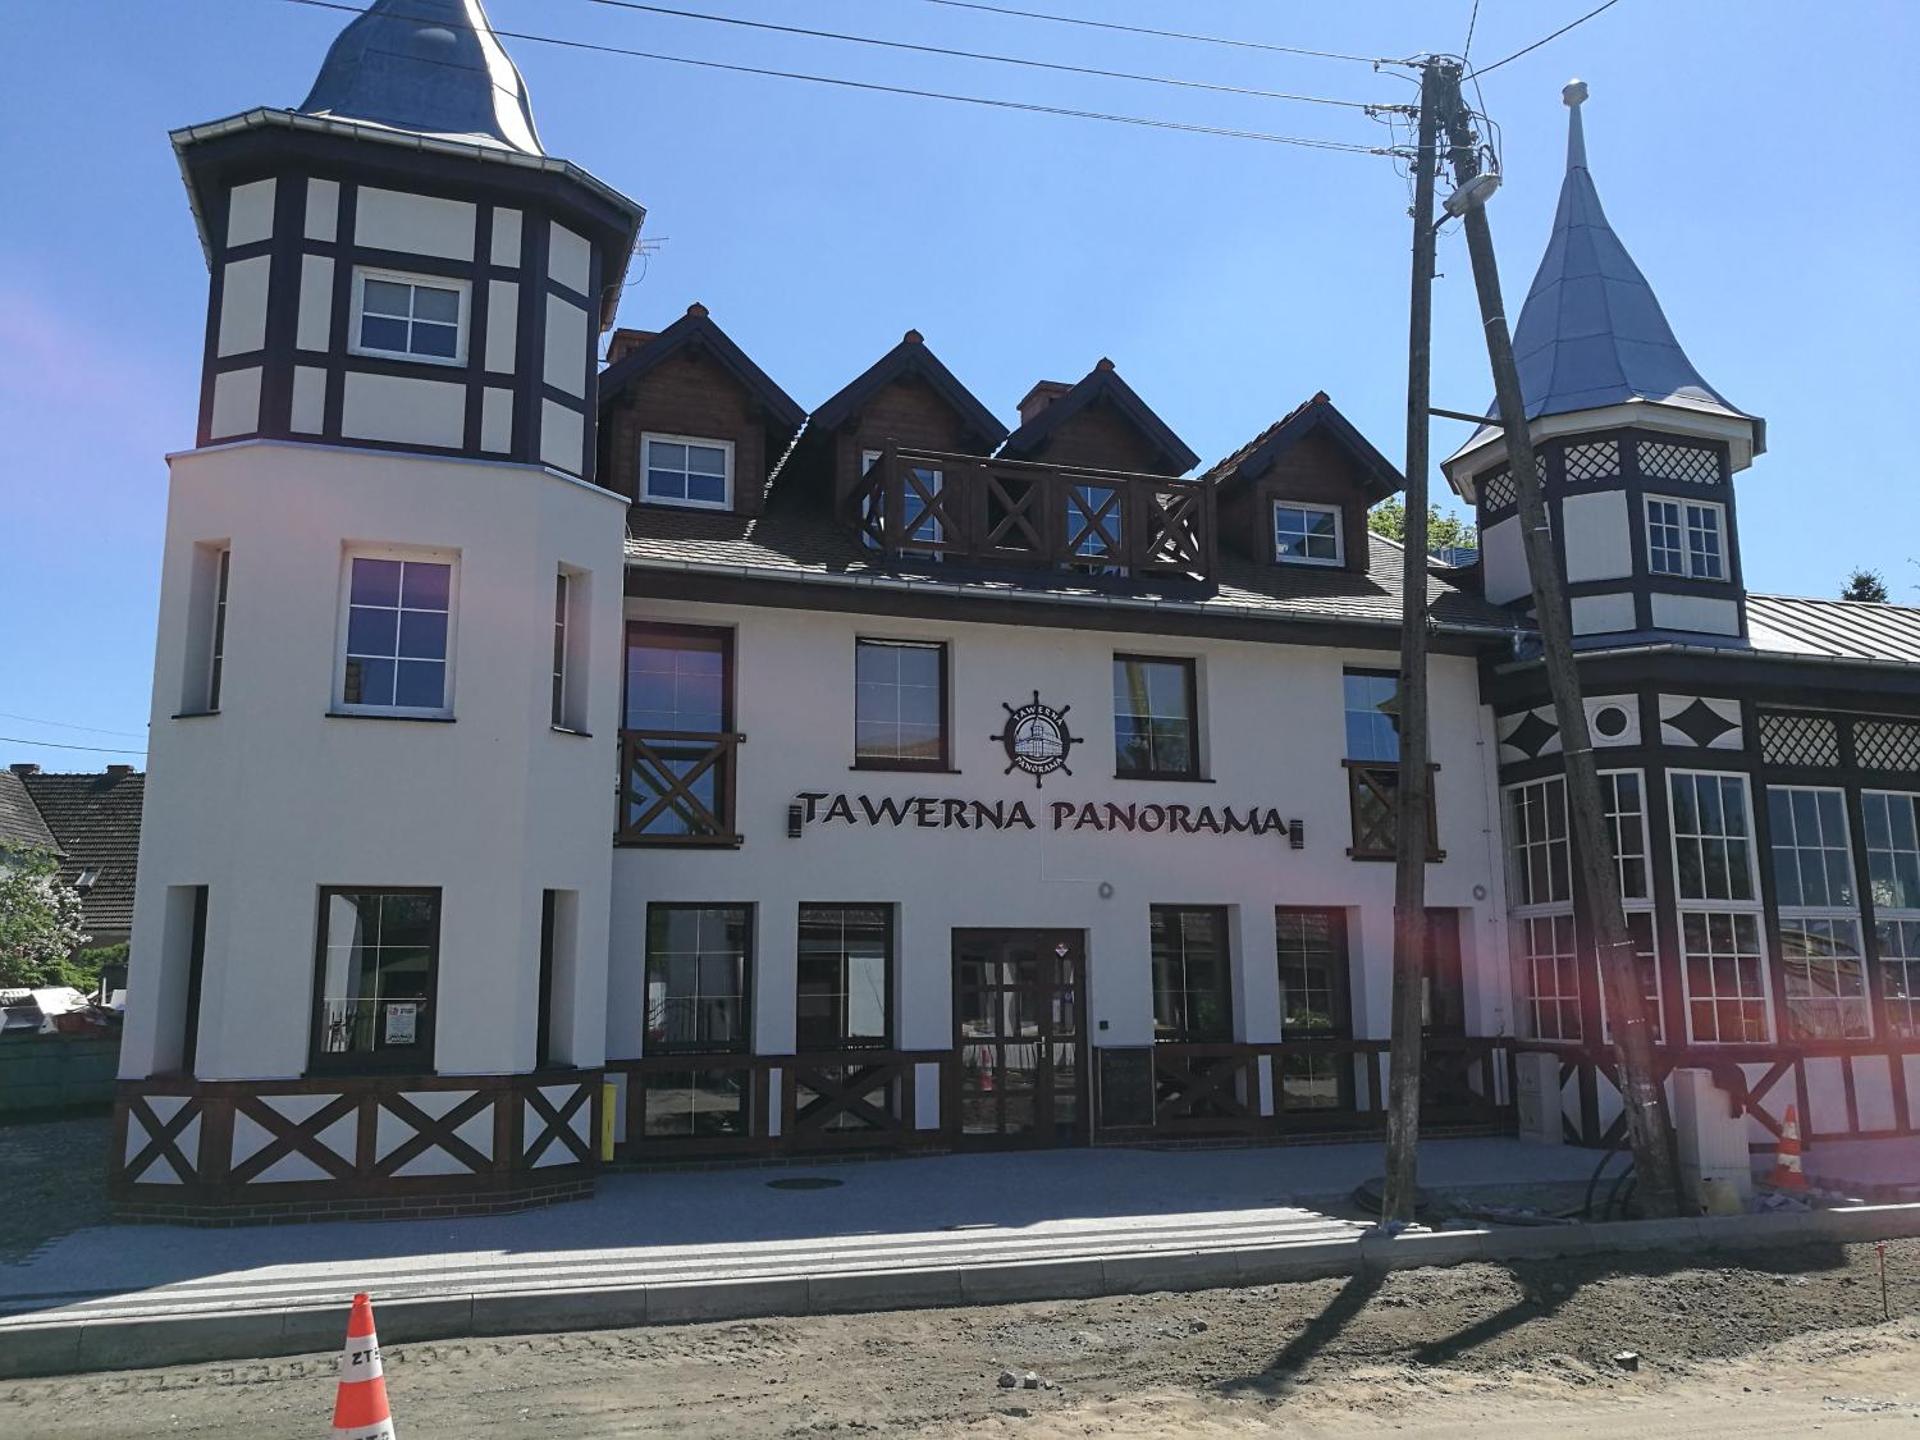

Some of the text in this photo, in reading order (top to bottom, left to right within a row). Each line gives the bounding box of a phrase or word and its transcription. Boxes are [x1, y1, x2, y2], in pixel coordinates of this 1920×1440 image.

[1013, 706, 1064, 726] TAWERNA
[1015, 756, 1063, 773] PANORAMA
[796, 792, 1289, 835] TAWERNA PANORAMA
